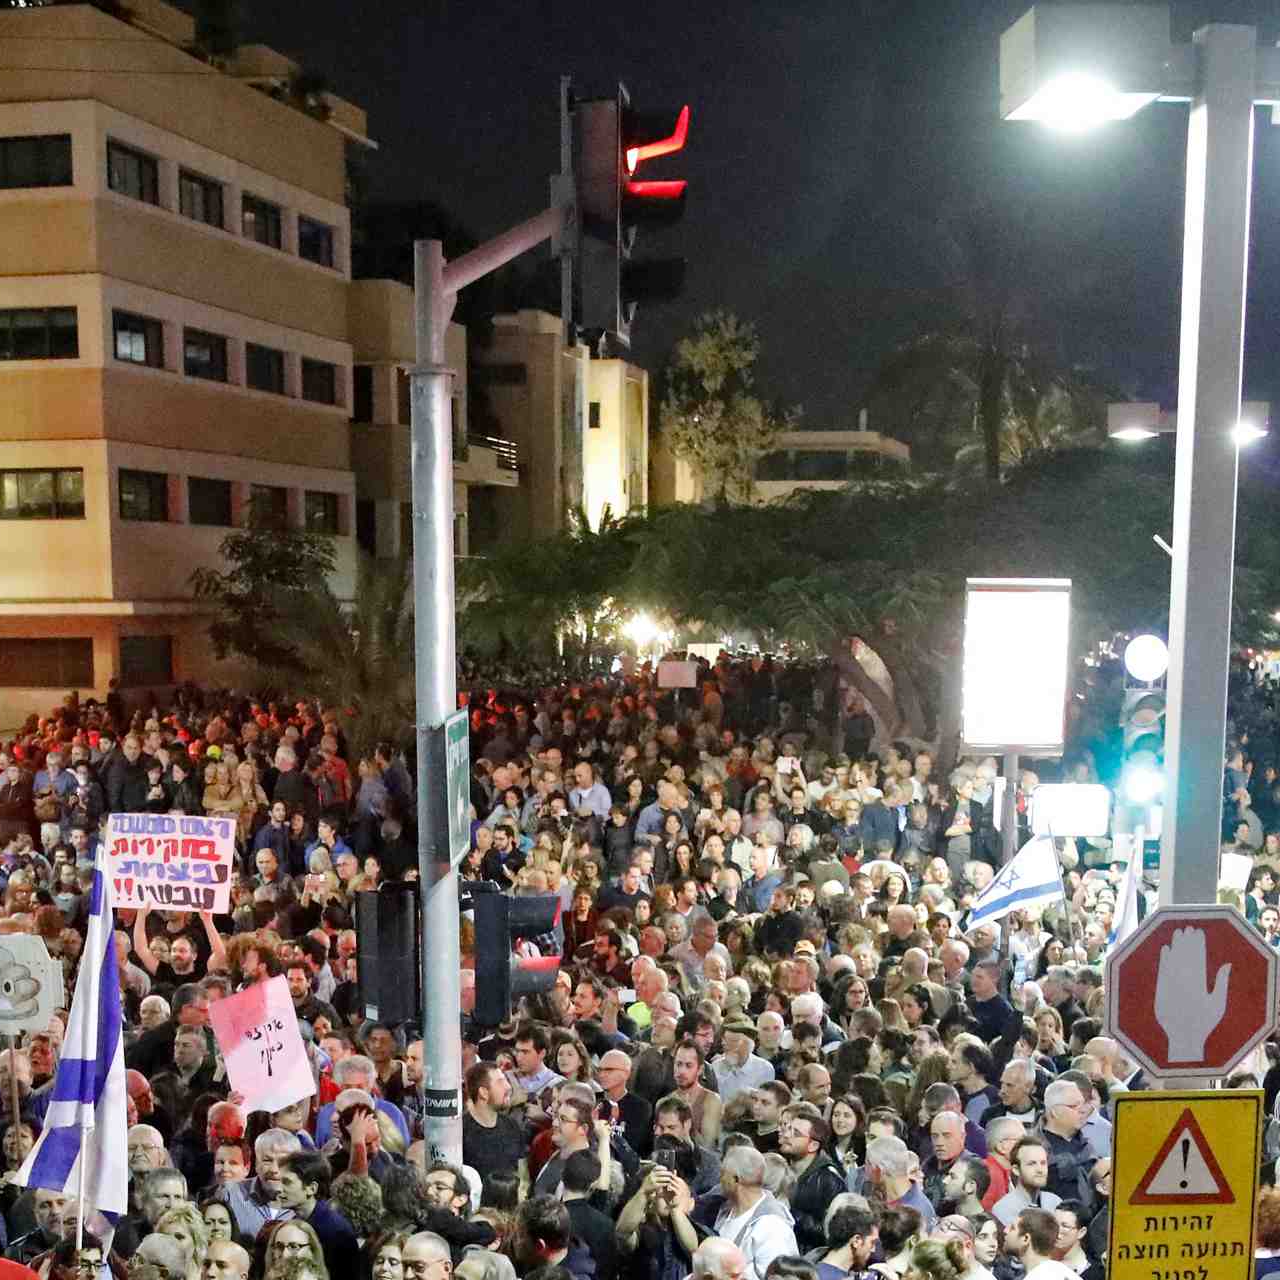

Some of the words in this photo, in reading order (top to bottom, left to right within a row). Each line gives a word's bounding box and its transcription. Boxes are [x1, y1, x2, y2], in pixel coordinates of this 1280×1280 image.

[1143, 1215, 1214, 1233] זהירות
[1117, 1242, 1170, 1260] חוצה
[1180, 1241, 1245, 1260] תנועה
